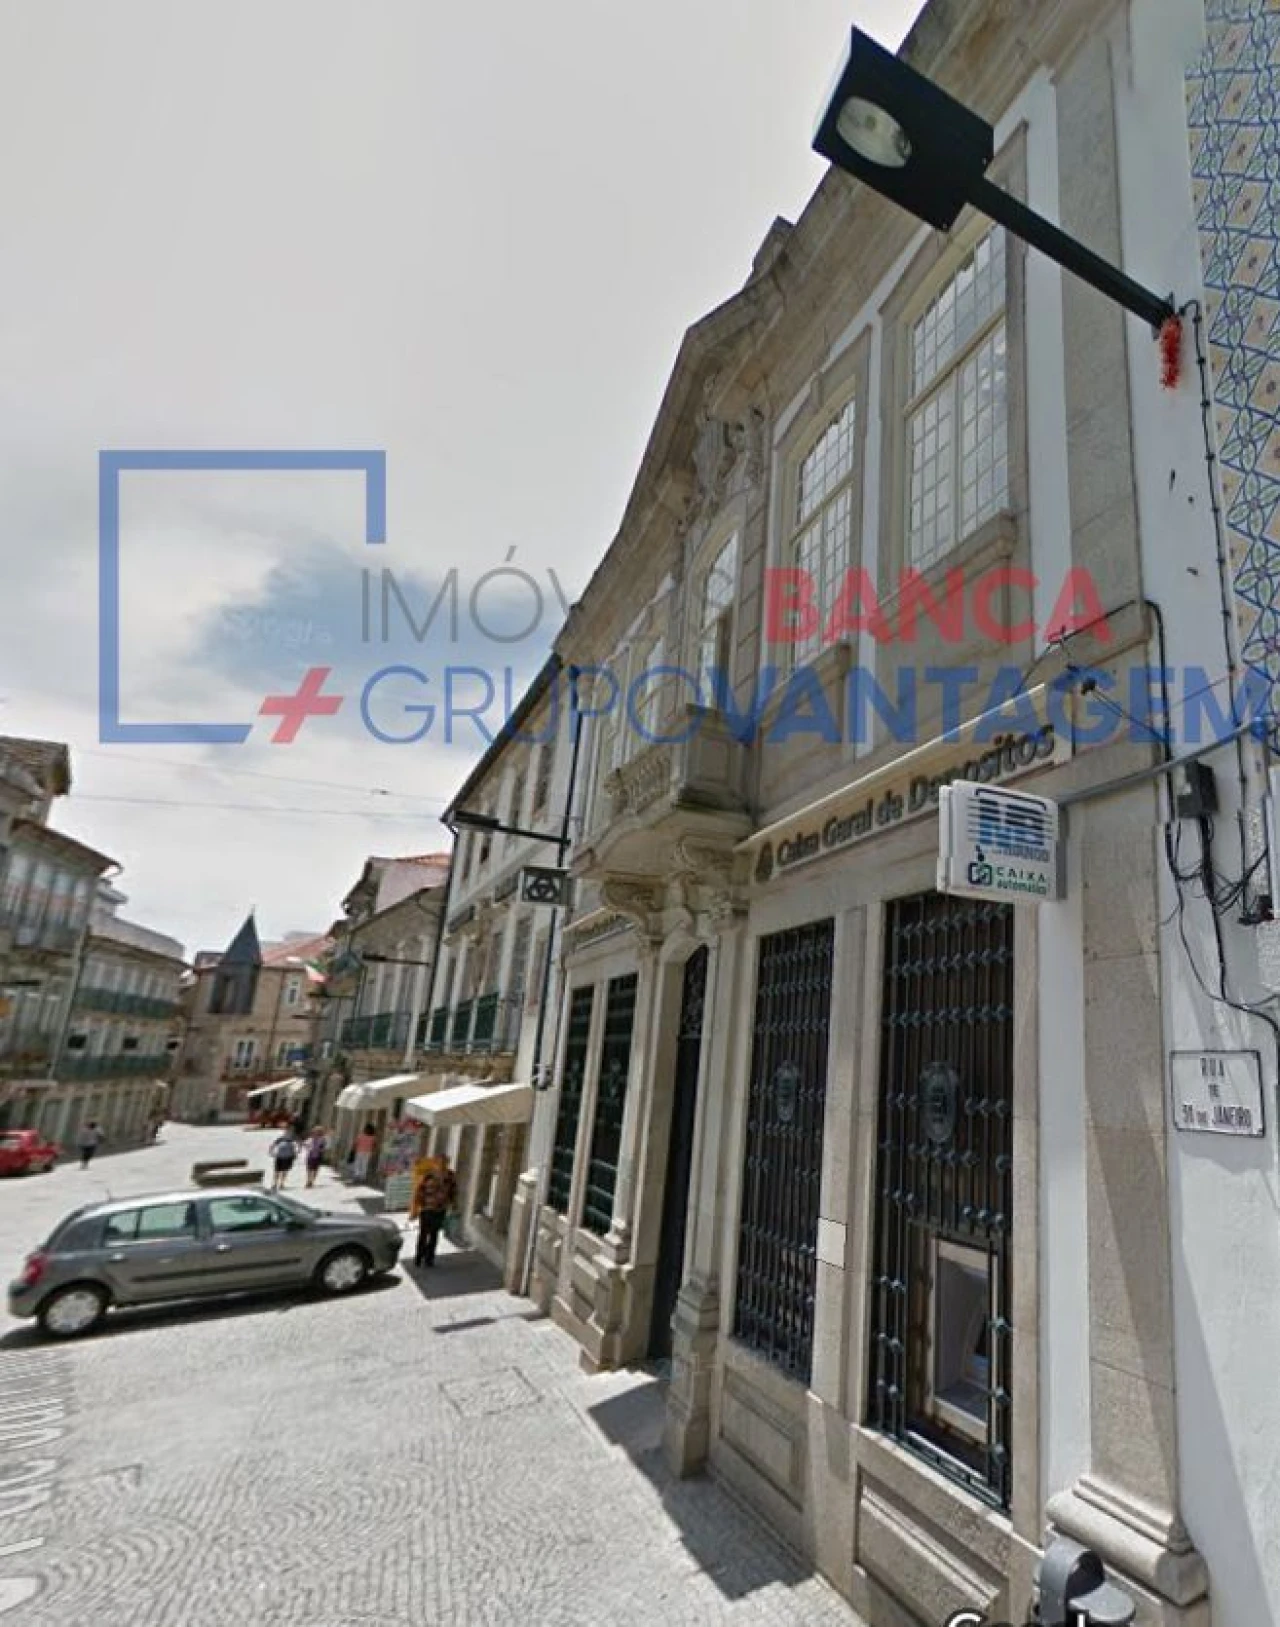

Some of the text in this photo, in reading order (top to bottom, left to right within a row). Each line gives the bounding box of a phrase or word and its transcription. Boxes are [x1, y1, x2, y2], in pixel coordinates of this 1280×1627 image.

[776, 831, 819, 867] Caixa
[822, 799, 874, 847] Geral
[876, 789, 904, 826] de
[996, 865, 1047, 882] CAIXA
[1200, 1057, 1225, 1077] RUA
[1212, 1105, 1252, 1129] JANEIRO
